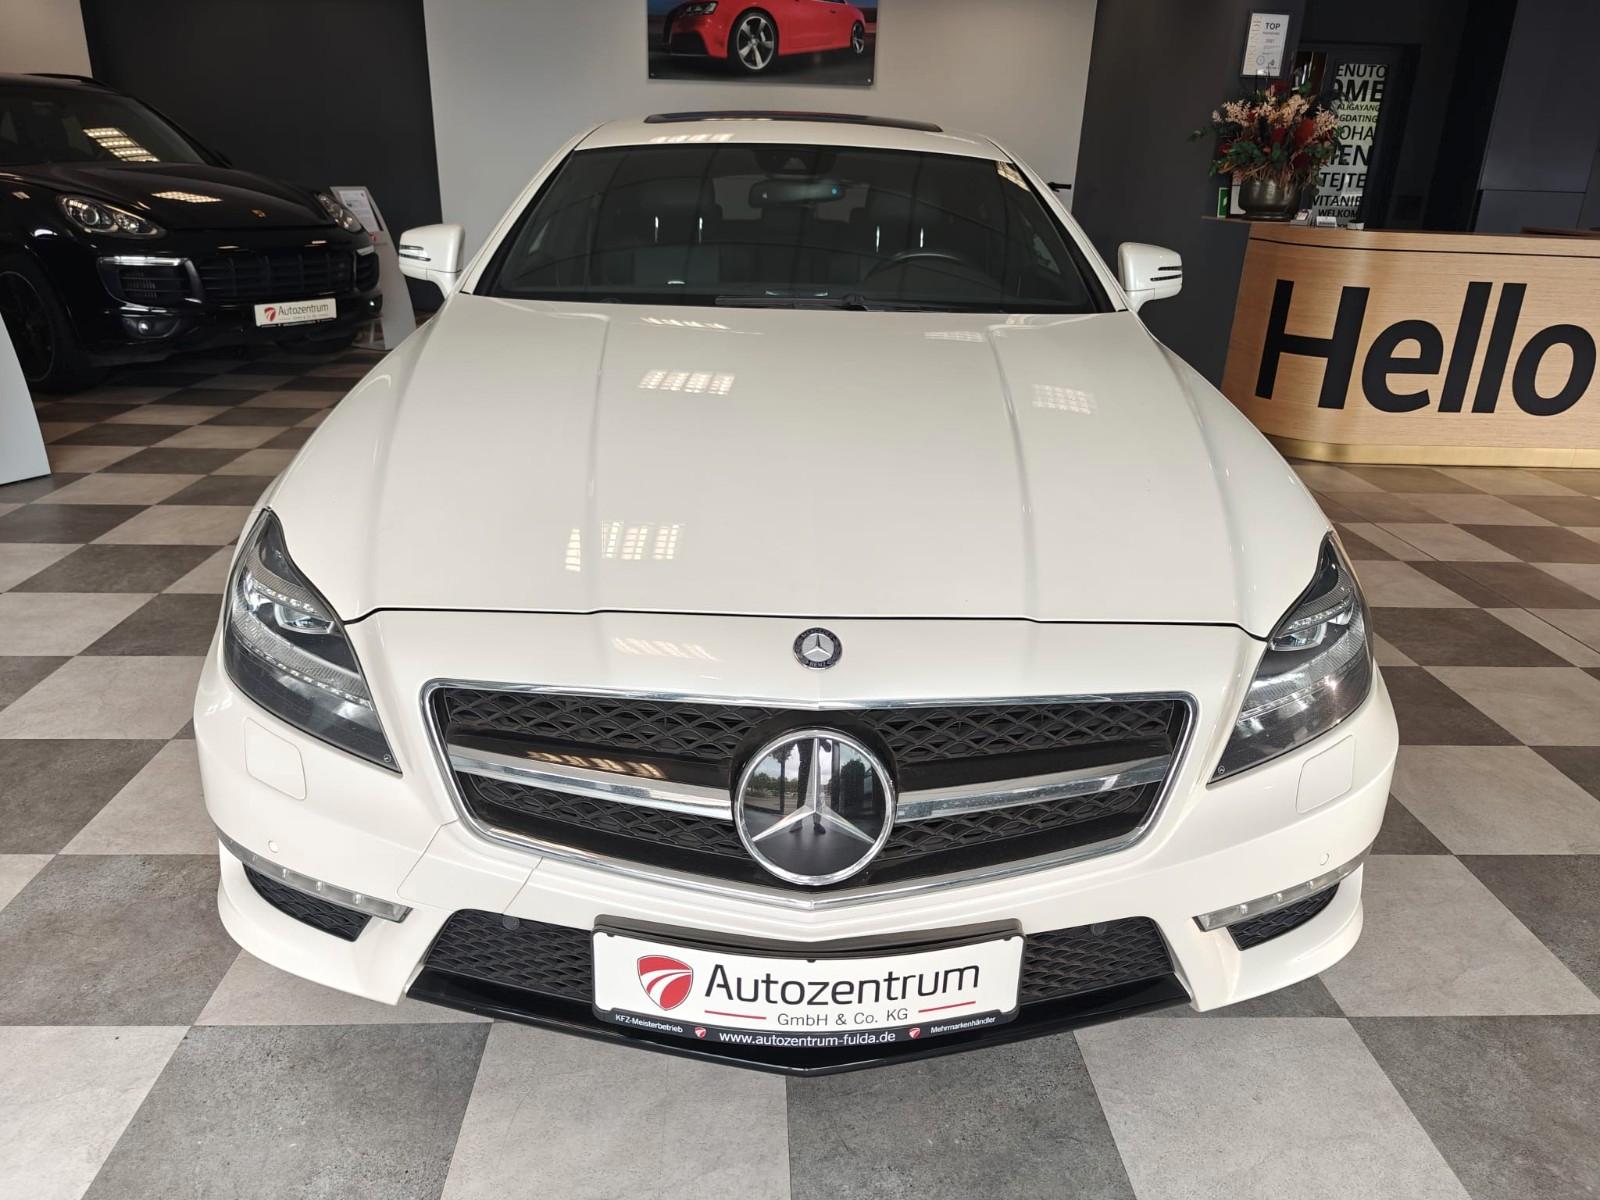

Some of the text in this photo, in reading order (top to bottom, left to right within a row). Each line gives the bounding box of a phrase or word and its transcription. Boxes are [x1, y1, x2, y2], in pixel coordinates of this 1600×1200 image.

[1265, 22, 1281, 30] TOP
[279, 303, 329, 316] Autozentrum
[1255, 279, 1597, 416] Hello
[704, 964, 980, 1006] Autozentrum
[777, 1007, 909, 1026] GmbH & Co. KG
[615, 1013, 997, 1048] KFZ-Meisterbetrieb www.autozentrum-fulda.de Mehrmarkenhändler
